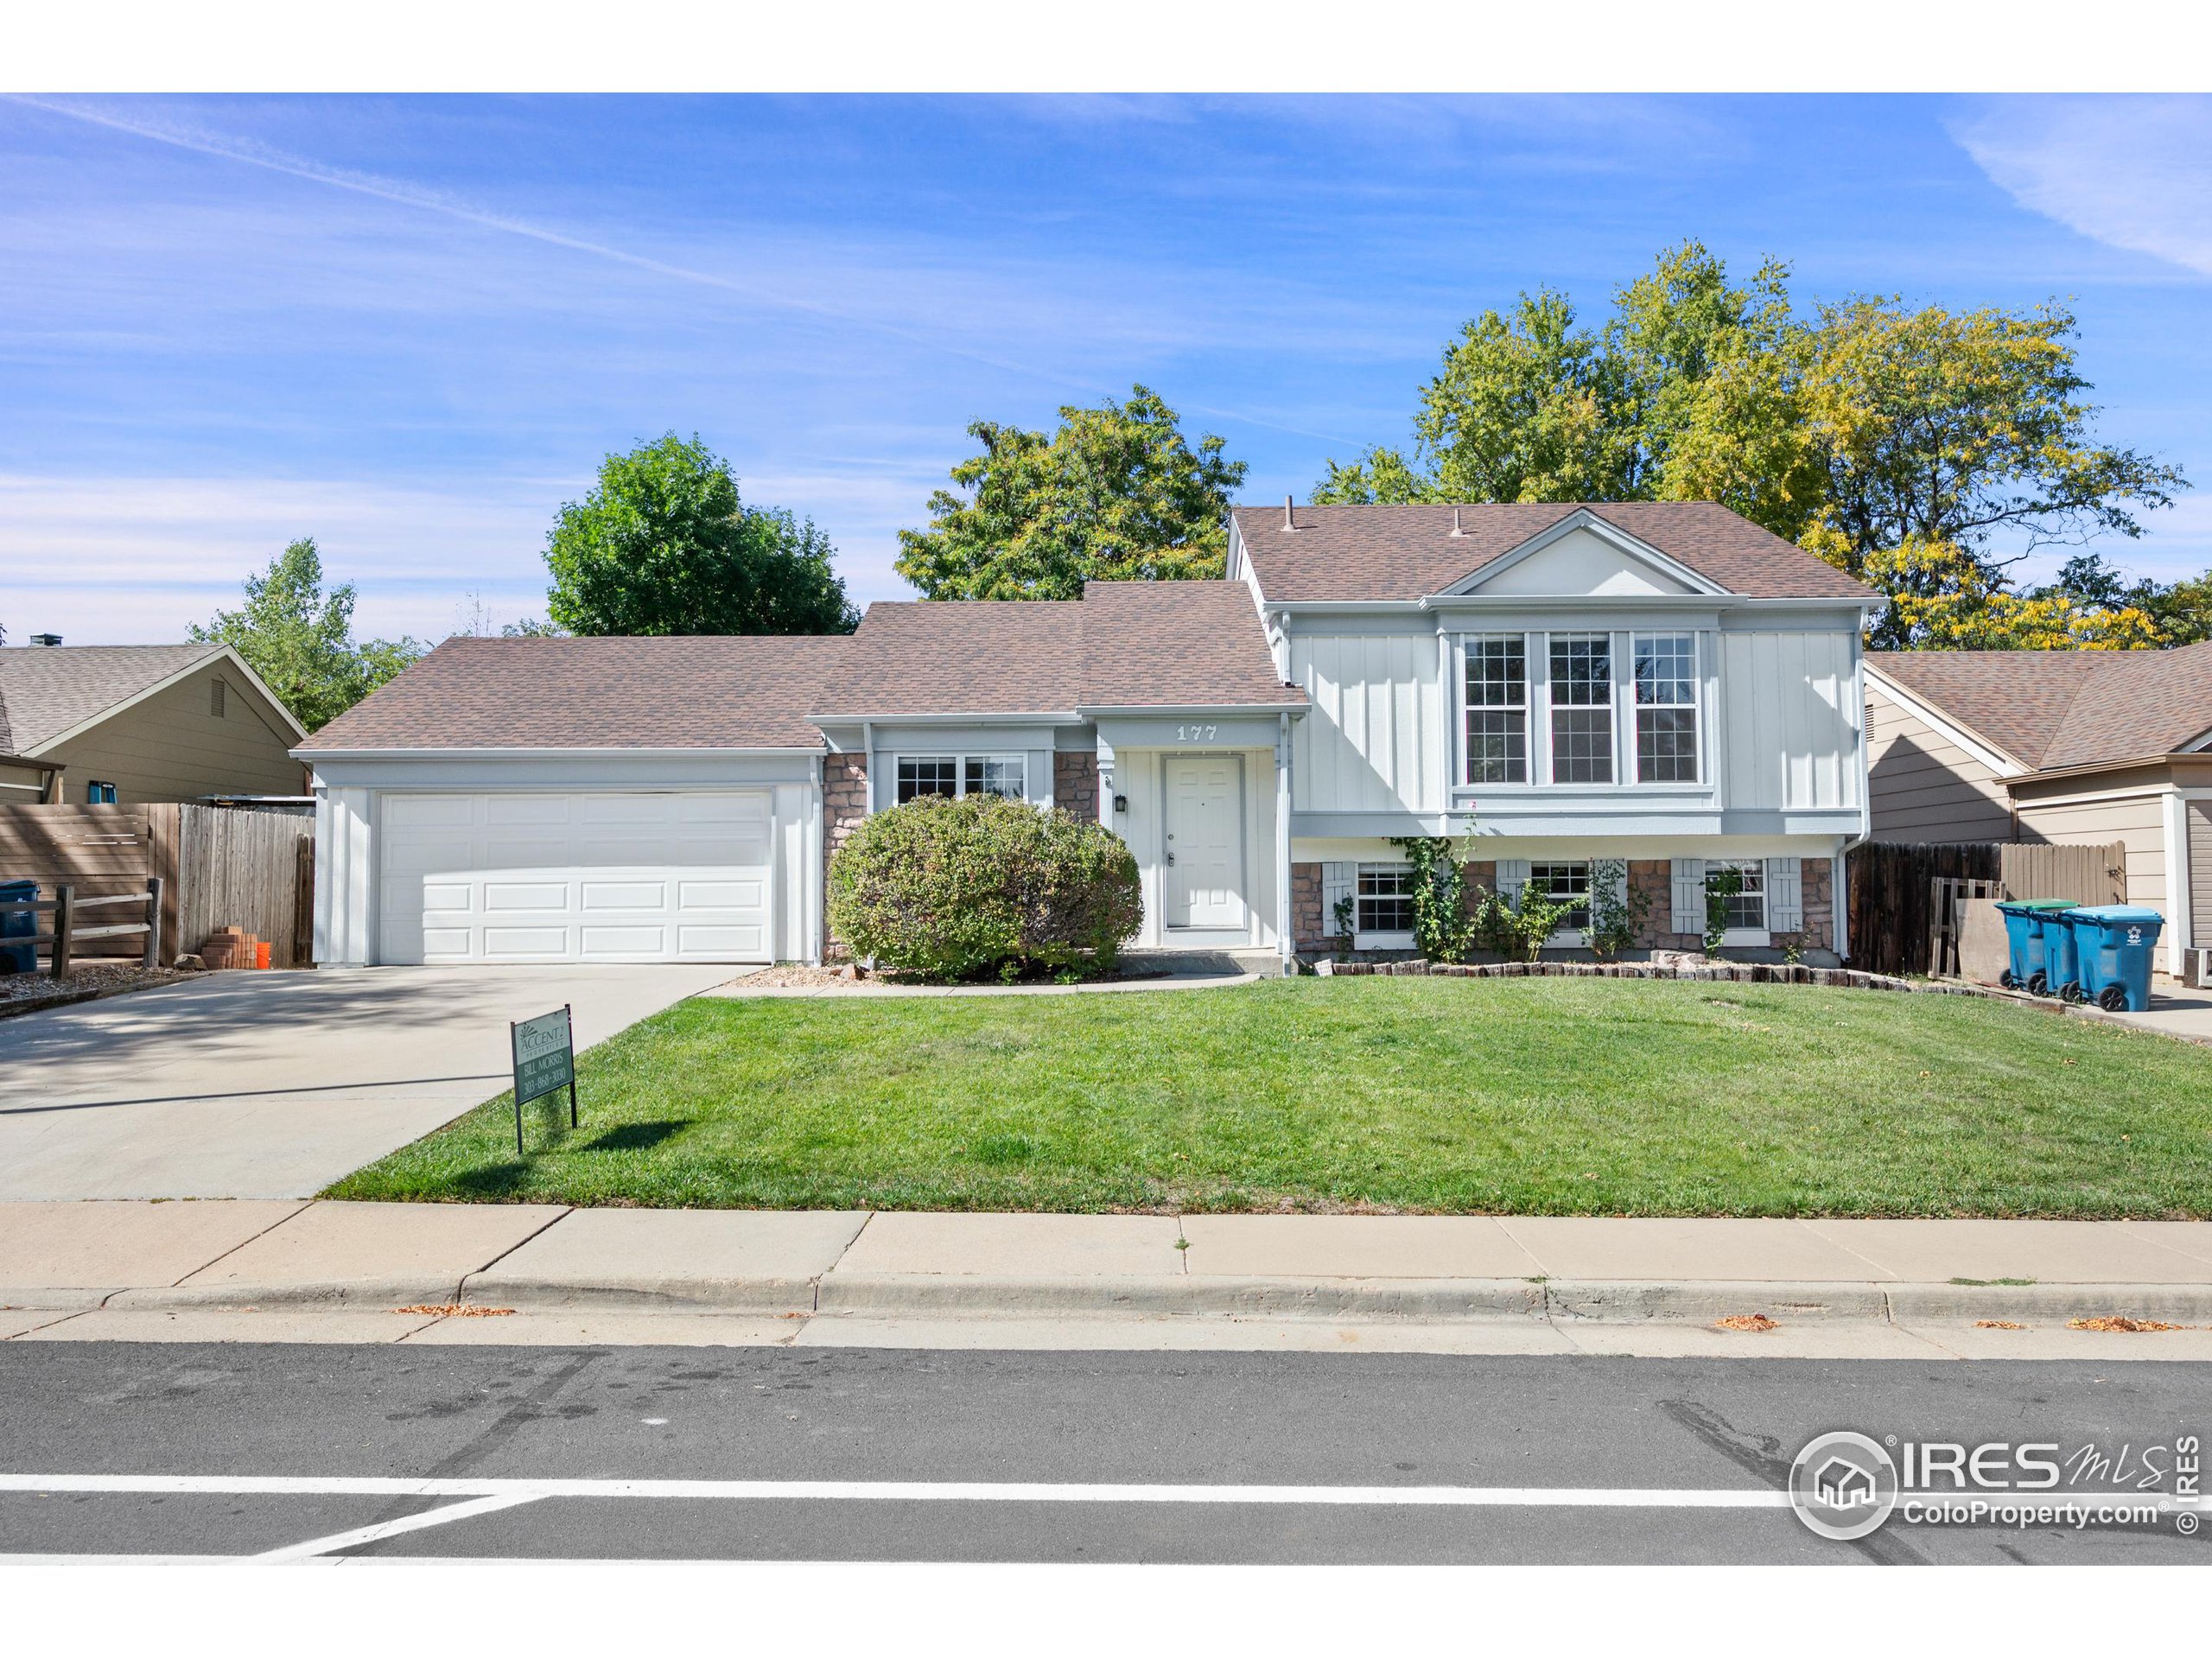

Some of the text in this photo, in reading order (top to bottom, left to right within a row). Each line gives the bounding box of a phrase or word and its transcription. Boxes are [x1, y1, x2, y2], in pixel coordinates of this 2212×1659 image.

[1177, 725, 1217, 741] 177
[524, 1051, 563, 1077] BILL MORRIS
[524, 1067, 566, 1095] 303-868-3030
